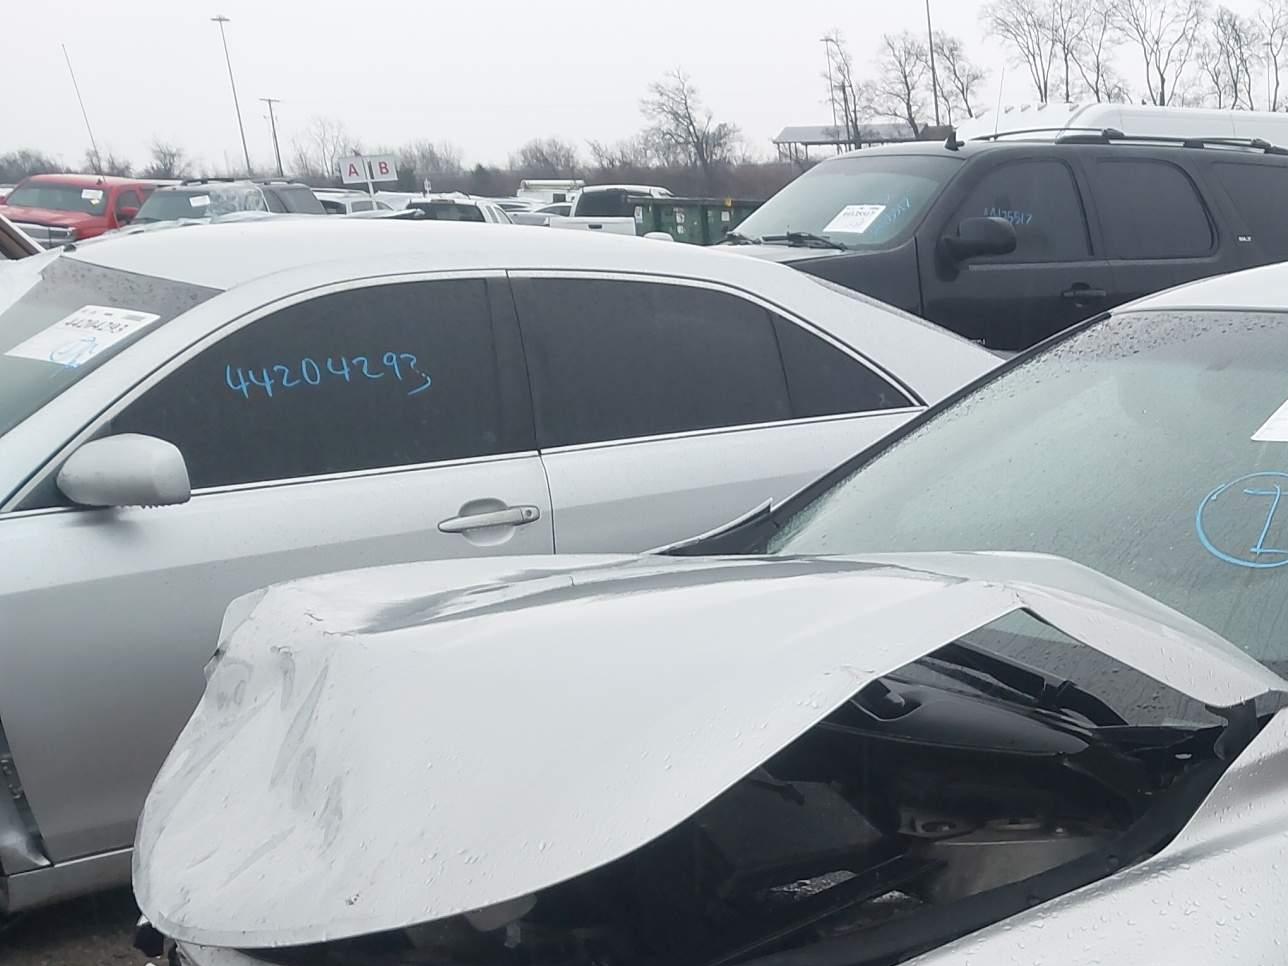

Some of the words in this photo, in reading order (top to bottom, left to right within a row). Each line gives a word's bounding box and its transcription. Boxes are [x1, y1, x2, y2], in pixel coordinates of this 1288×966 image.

[348, 163, 360, 177] A
[378, 161, 390, 175] B
[224, 351, 432, 399] 44204293
